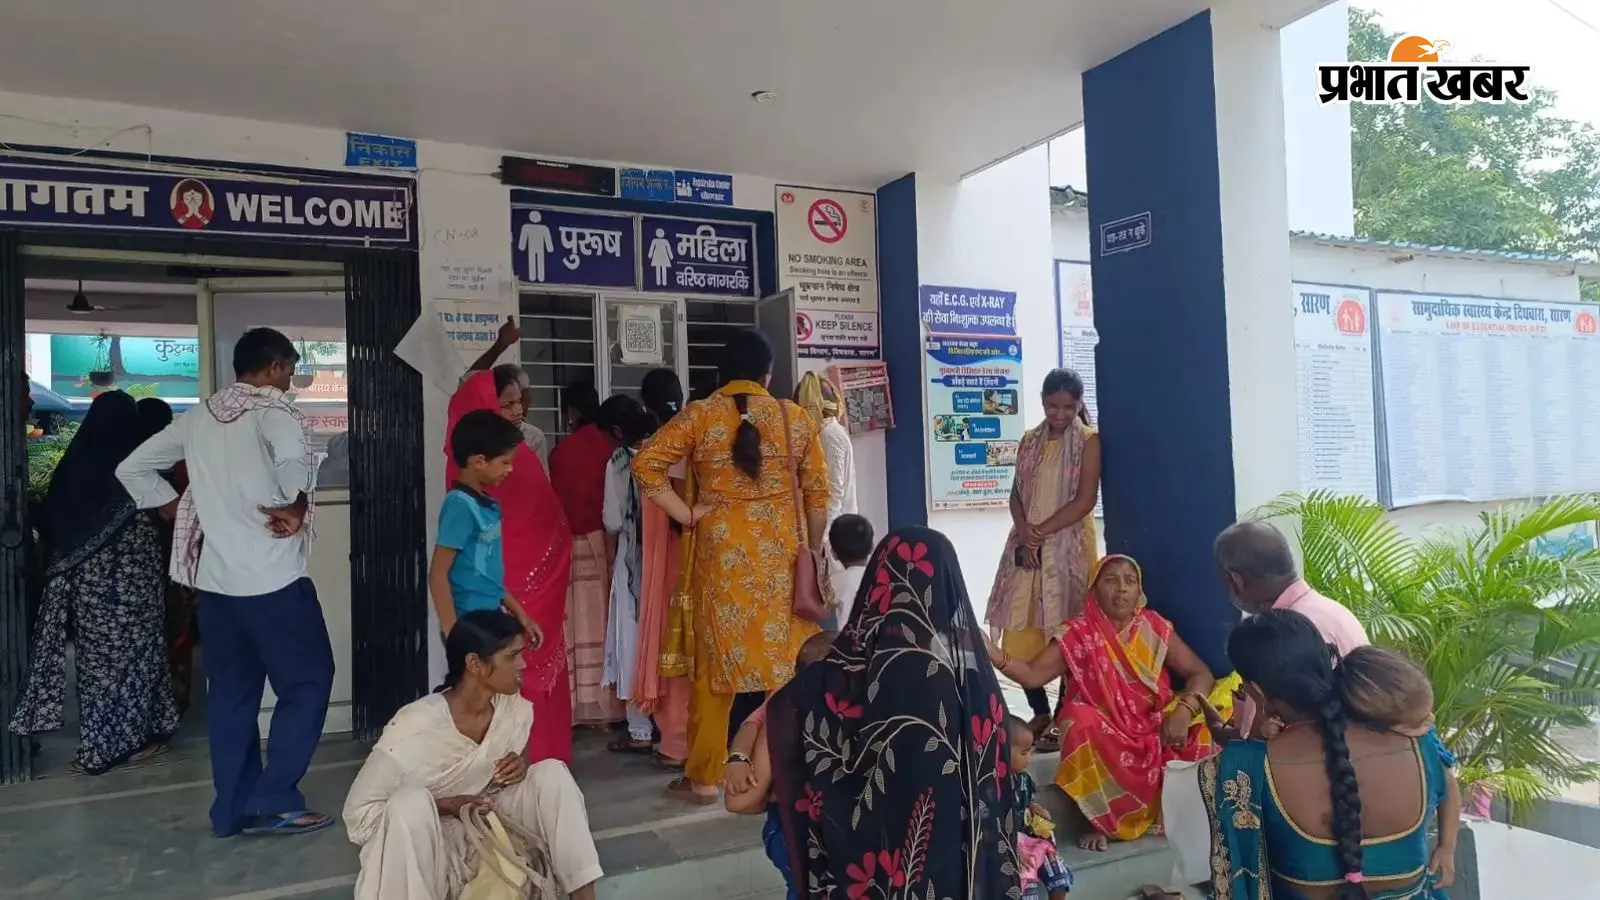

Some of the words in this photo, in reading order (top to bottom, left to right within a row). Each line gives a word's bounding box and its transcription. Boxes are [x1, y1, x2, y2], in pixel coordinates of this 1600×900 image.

[226, 191, 404, 231] WELCOME
[676, 224, 748, 263] महिला
[788, 253, 801, 263] NO
[803, 254, 843, 266] SMOKING
[845, 256, 868, 268] AREA
[676, 266, 706, 288] वरिष्ठ
[789, 266, 816, 276] Smoking
[944, 294, 969, 308] E.C.G.
[969, 293, 981, 308] एवं
[981, 296, 1006, 309] X-RAY
[1300, 292, 1331, 315] सारण
[1411, 299, 1461, 322] सामुदायिक
[1463, 304, 1492, 319] स्वास्थ्य
[1493, 302, 1512, 320] केन्द्र
[1550, 308, 1571, 322] सारण
[815, 320, 838, 331] KEEP
[839, 321, 873, 332] SILENCE
[922, 309, 933, 323] की
[934, 310, 949, 325] सेवा
[979, 313, 1005, 327] उपलब्ध
